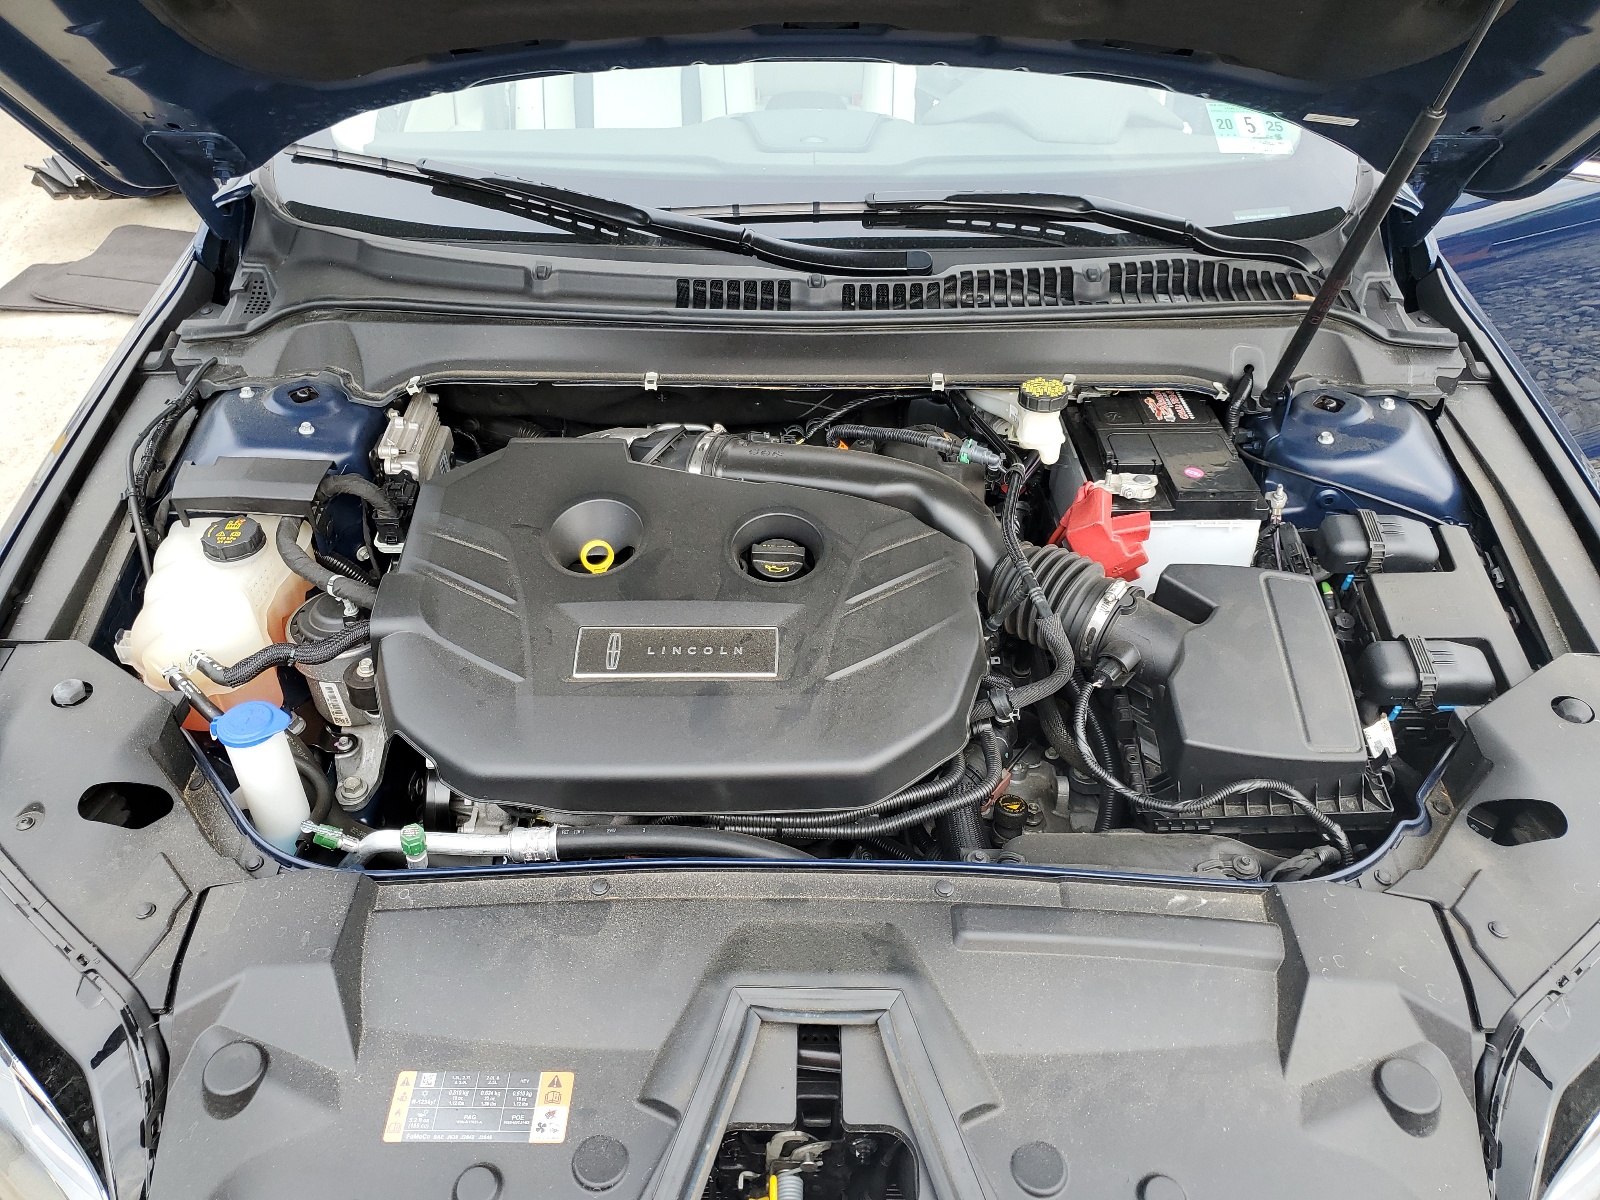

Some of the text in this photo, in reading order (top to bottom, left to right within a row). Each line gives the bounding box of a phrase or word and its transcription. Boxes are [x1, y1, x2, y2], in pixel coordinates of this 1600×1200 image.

[1216, 116, 1284, 134] 20 5 25
[647, 646, 744, 655] LINCOLN
